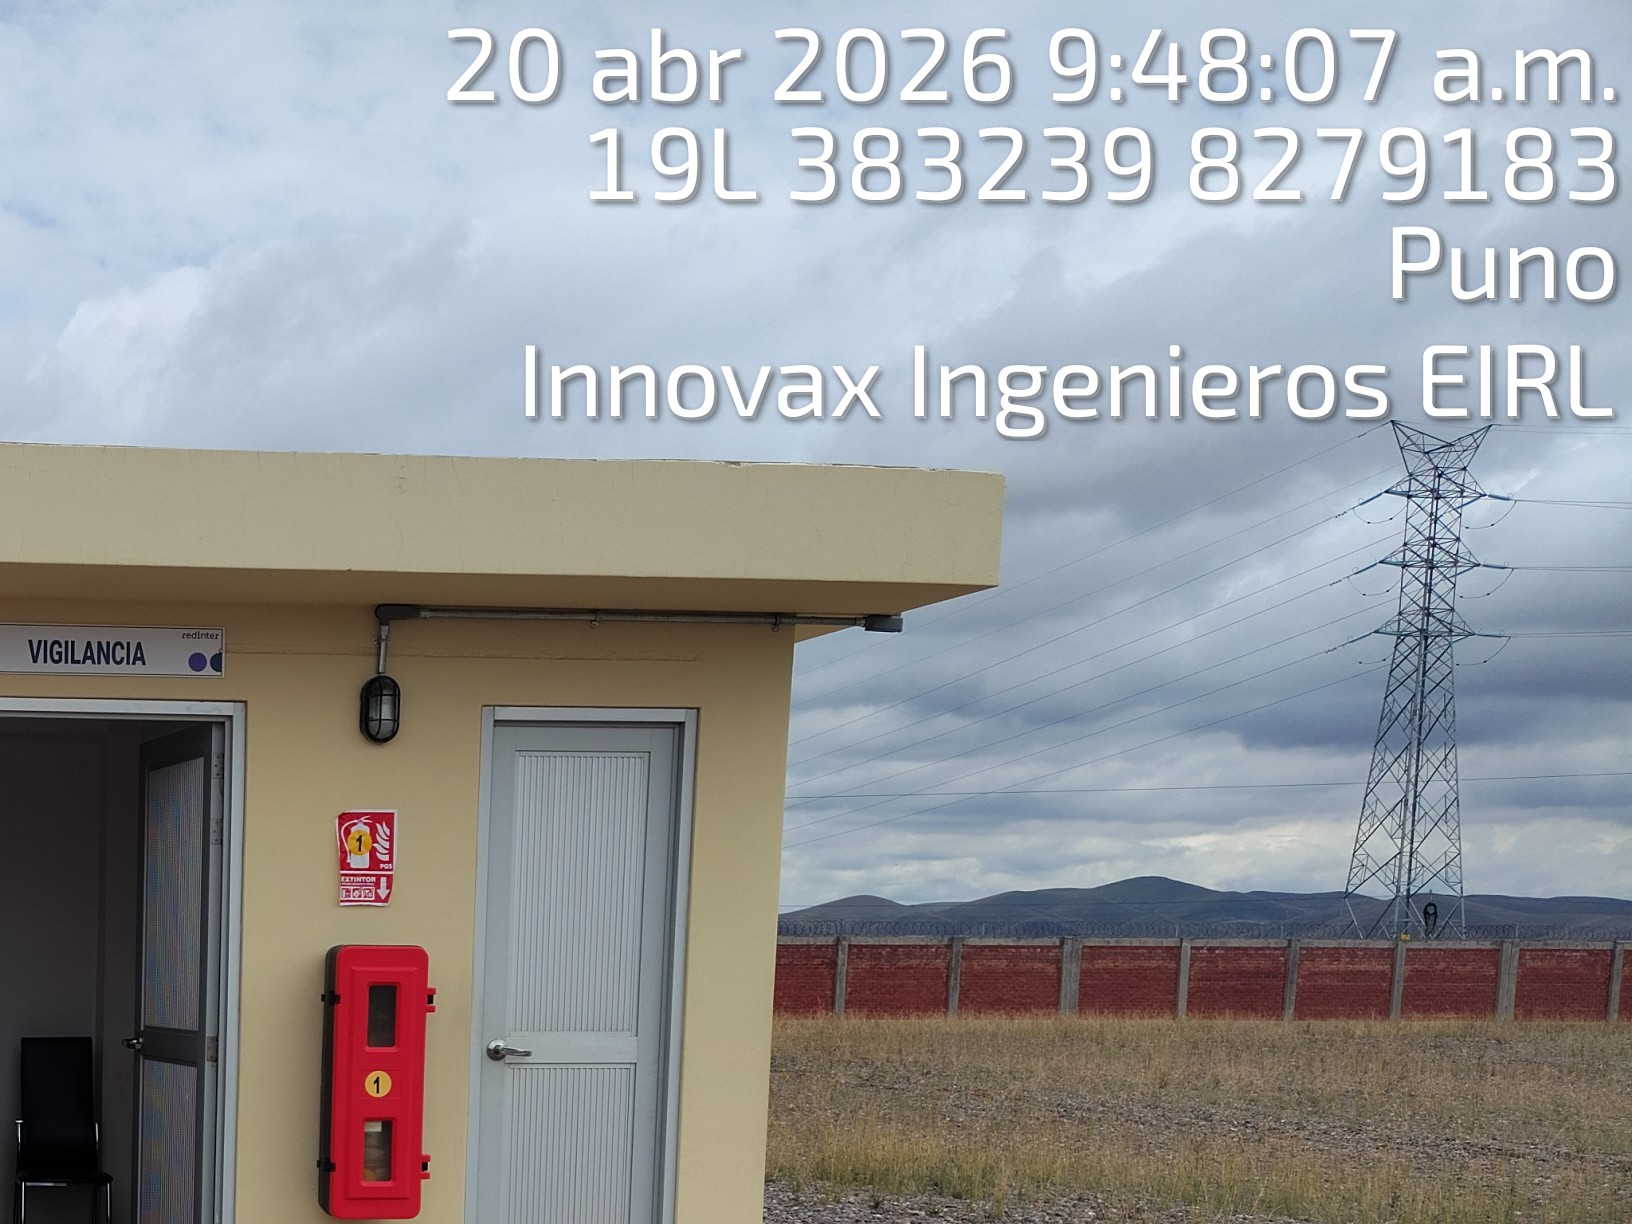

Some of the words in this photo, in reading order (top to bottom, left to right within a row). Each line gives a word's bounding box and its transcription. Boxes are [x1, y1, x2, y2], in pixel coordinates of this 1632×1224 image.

[28, 639, 146, 666] VIGILANCIA
[356, 835, 362, 851] 1
[373, 1076, 379, 1094] 1
